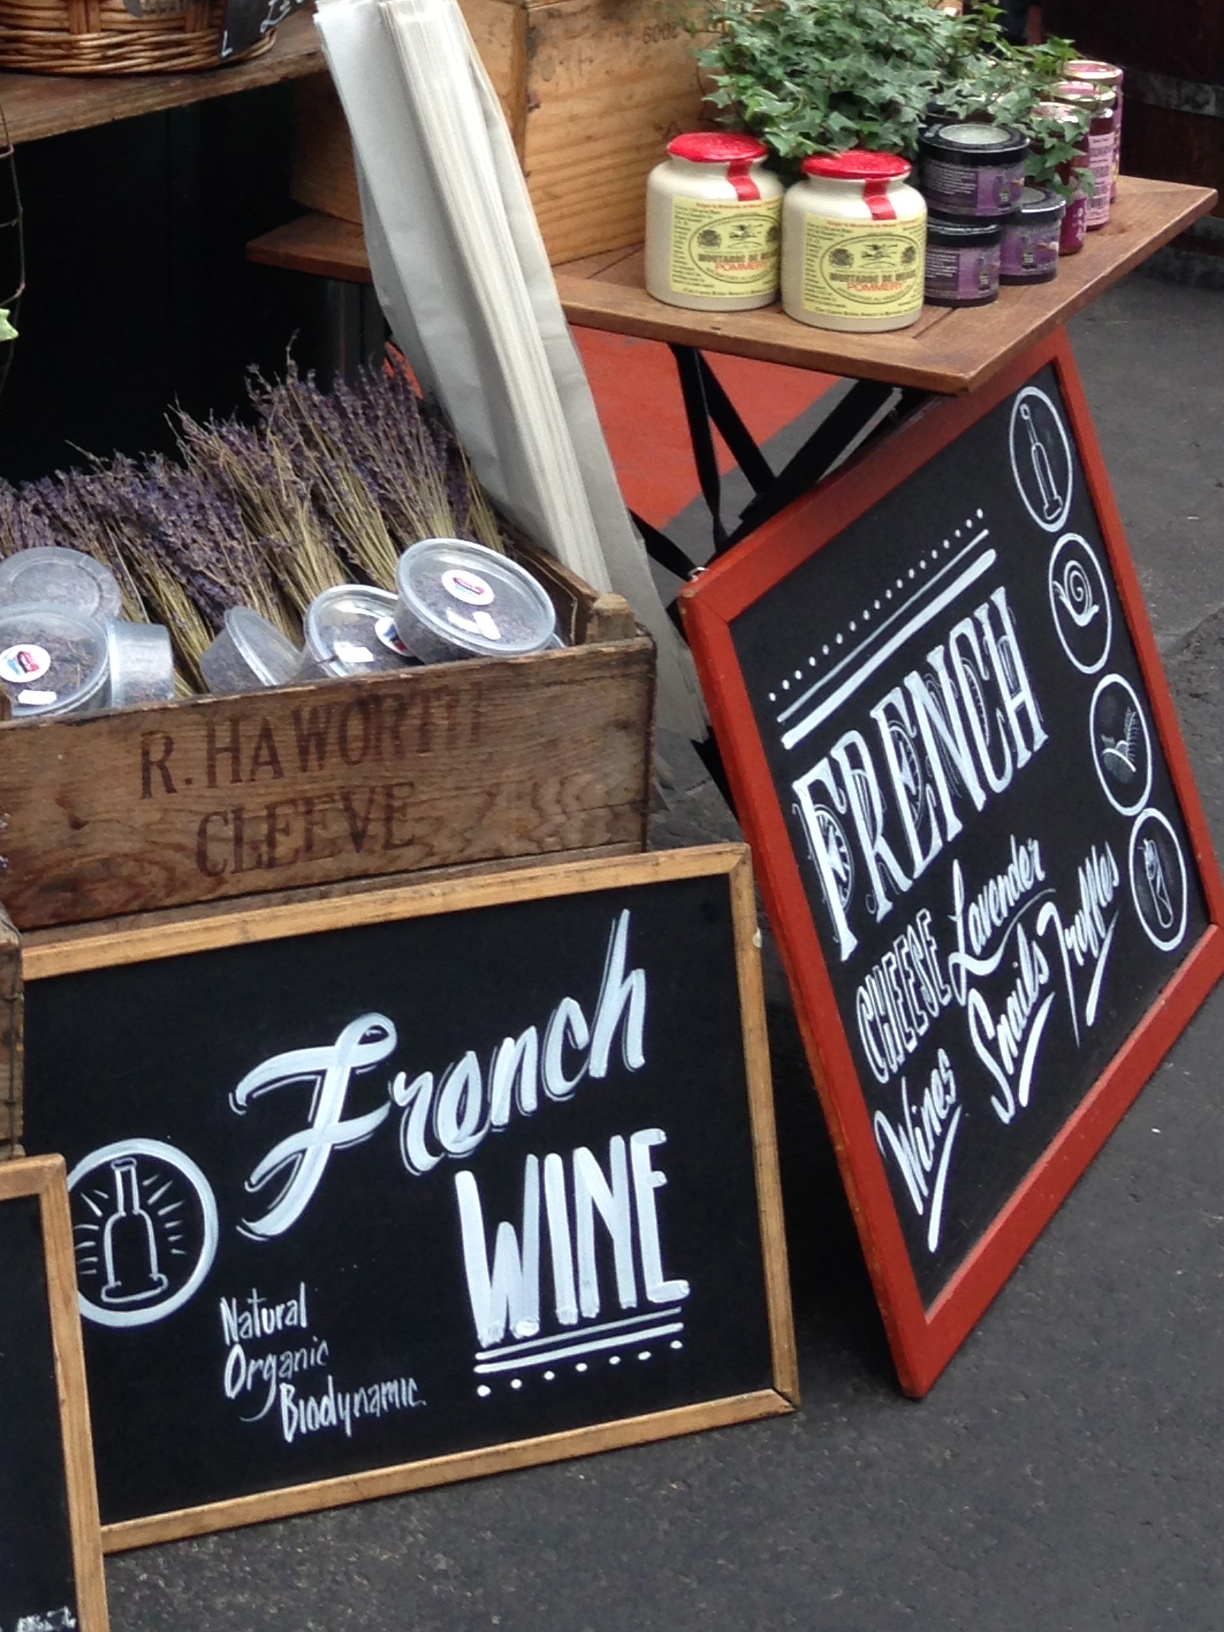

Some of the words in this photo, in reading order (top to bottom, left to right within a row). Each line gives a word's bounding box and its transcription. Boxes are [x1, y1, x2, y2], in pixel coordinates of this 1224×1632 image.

[196, 780, 416, 878] CLEEVE
[792, 585, 1049, 961] FRENCH
[857, 908, 951, 1084] CHEESE
[948, 834, 1046, 1006] Lavender
[874, 1048, 960, 1218] Wines
[967, 922, 1051, 1125] Snails
[1037, 840, 1120, 1049] Truffles
[229, 909, 646, 1242] French
[219, 1280, 308, 1347] Natural
[455, 1128, 690, 1348] WINE
[224, 1335, 330, 1422] Organic
[279, 1374, 427, 1443] Biodynamic
